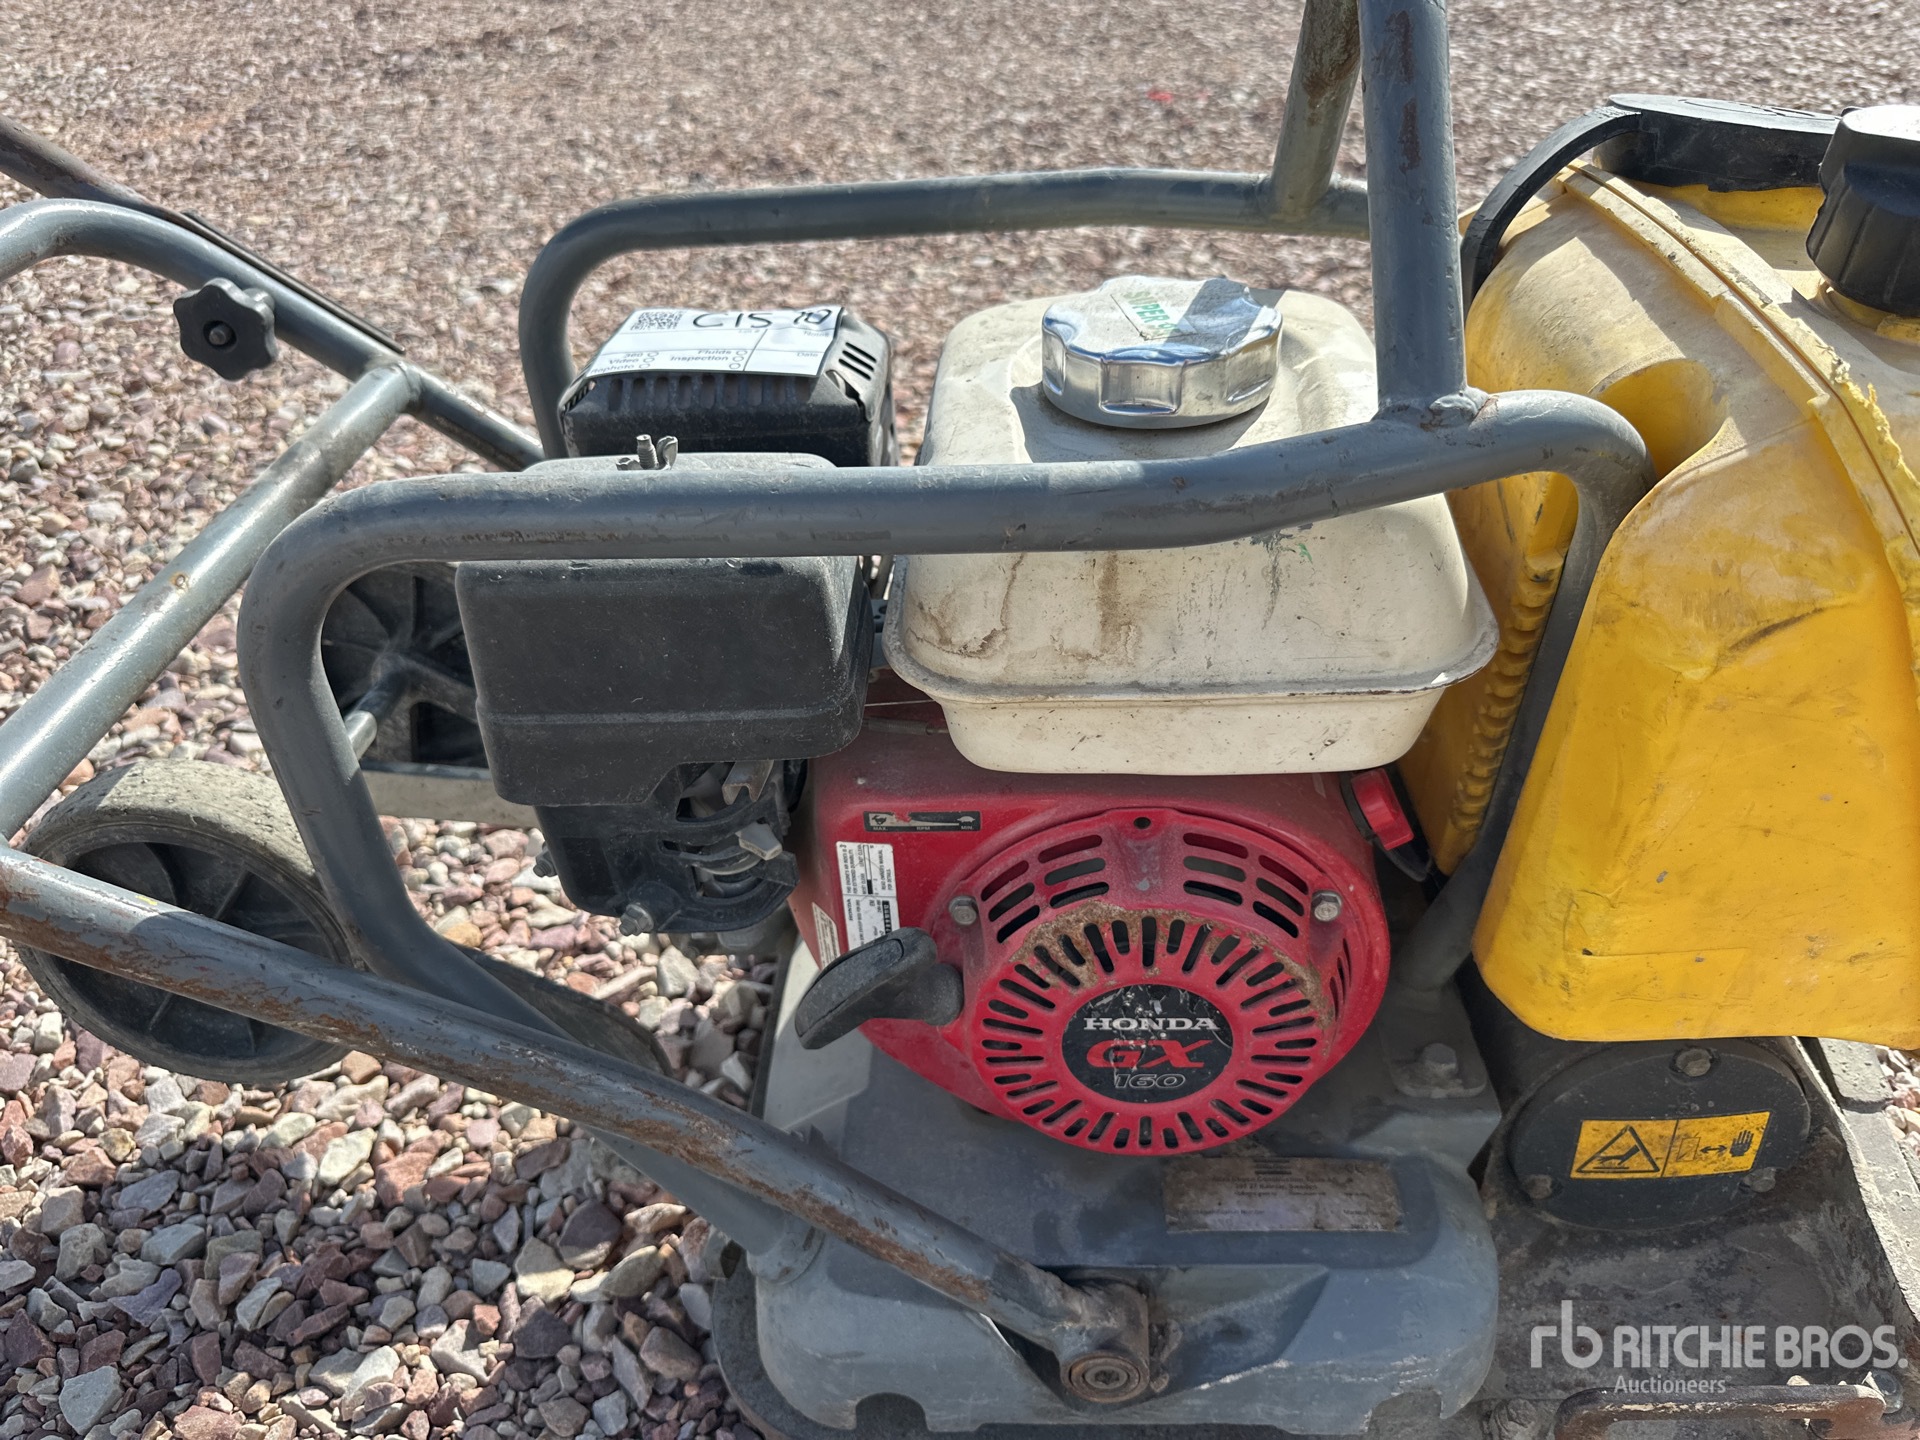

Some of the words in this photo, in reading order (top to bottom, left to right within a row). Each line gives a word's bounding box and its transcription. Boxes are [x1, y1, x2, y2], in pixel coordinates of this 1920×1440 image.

[609, 357, 640, 365] Video
[670, 355, 729, 363] Inspection
[1083, 1017, 1220, 1031] HONDA
[1086, 1039, 1213, 1069] GX
[1114, 1073, 1187, 1089] 160
